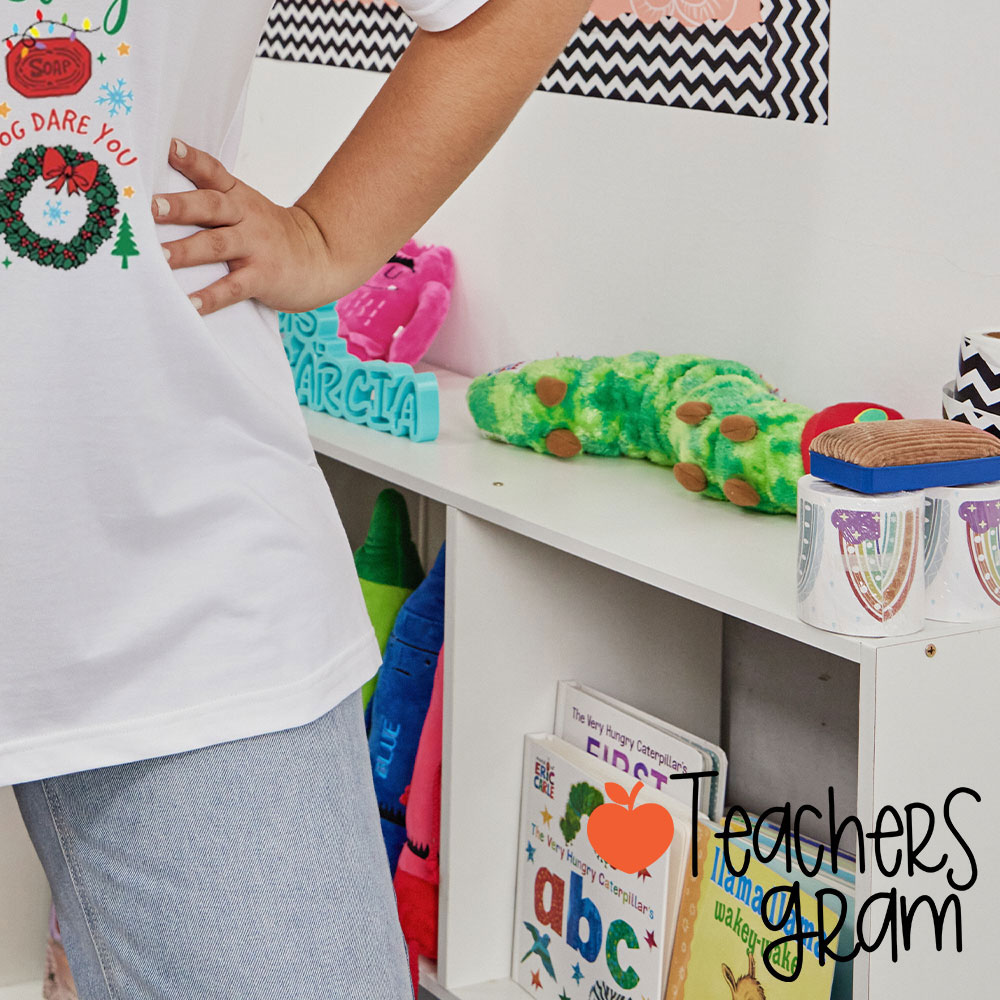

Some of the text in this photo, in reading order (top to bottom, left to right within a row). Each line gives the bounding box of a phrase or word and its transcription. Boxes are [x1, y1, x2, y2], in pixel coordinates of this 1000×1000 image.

[30, 59, 71, 78] SOAP
[31, 108, 90, 136] DARE
[92, 122, 139, 169] YOU
[374, 715, 402, 780] BLUE
[572, 706, 688, 775] The Very Hungry Caterpillar's
[534, 775, 555, 800] CARLE
[531, 822, 655, 920] The Very Hungry Caterpillar's
[710, 845, 762, 917] llama
[533, 866, 640, 990] abc
